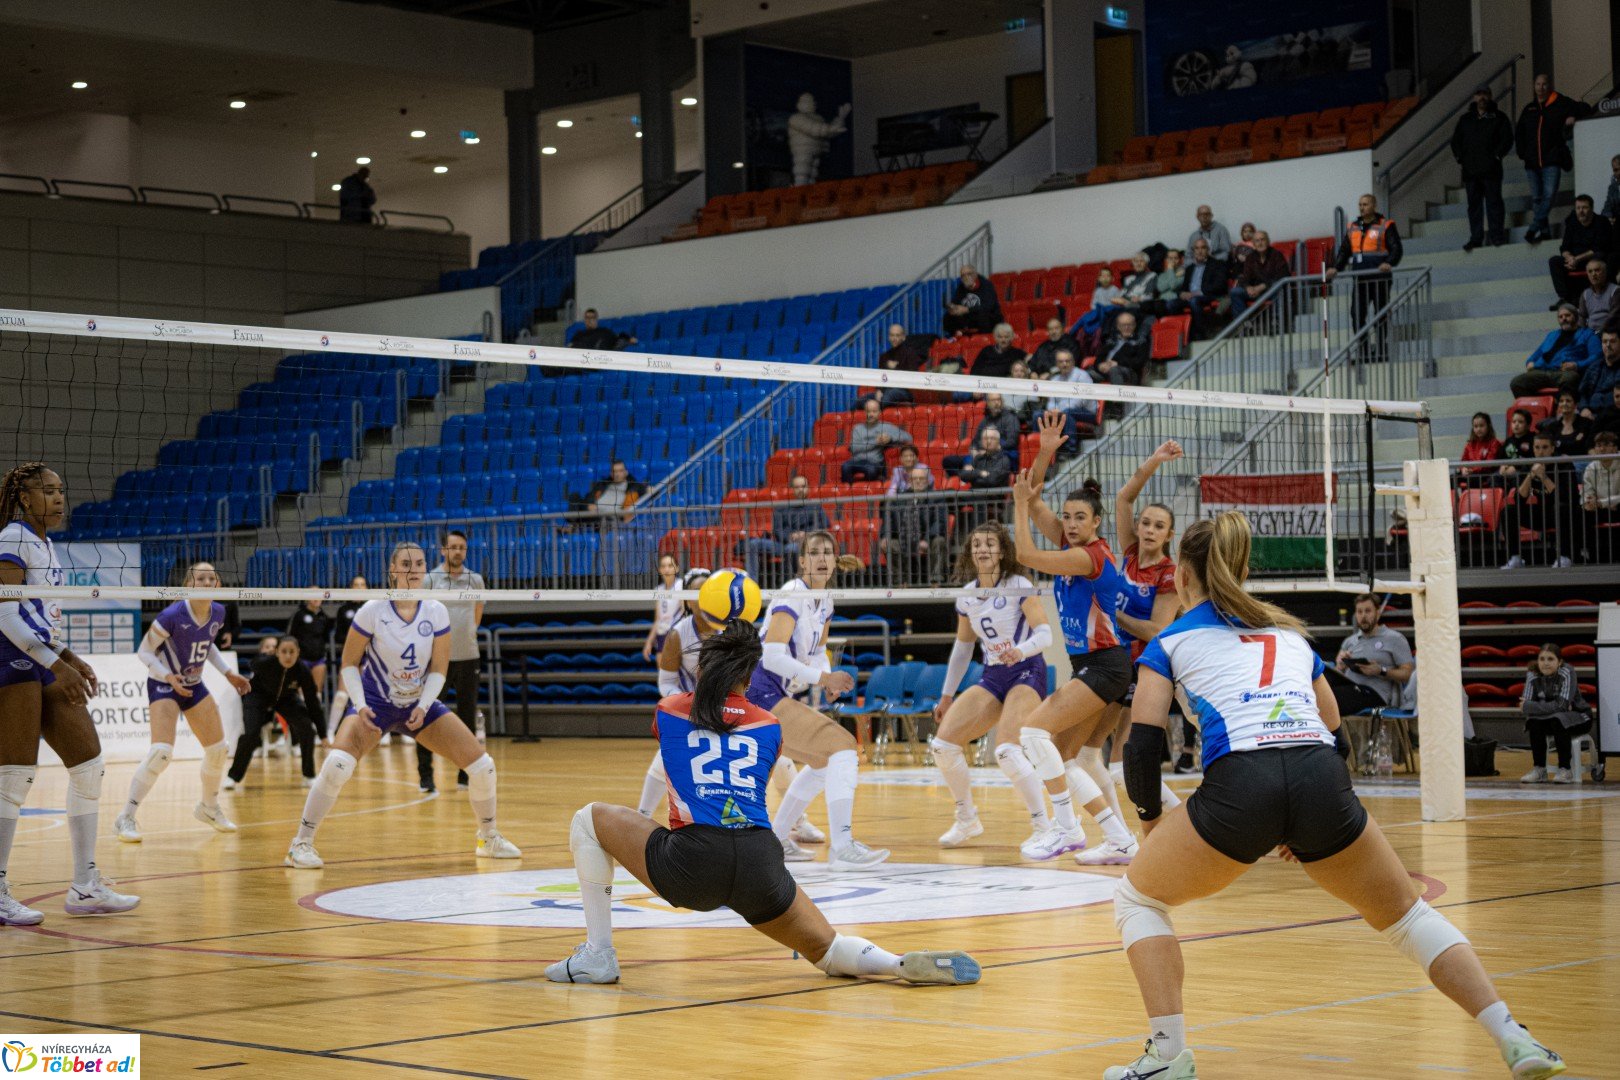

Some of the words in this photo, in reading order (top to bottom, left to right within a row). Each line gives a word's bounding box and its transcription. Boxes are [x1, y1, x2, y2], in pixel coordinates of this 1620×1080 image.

[0, 316, 26, 326] ATUM
[65, 571, 101, 585] IGA
[1, 590, 23, 598] ATUM
[980, 616, 998, 639] 6
[188, 640, 211, 663] 15
[400, 642, 417, 666] 4
[1238, 634, 1276, 688] 7
[98, 681, 145, 698] REGY
[91, 707, 151, 725] ORTCE
[687, 729, 757, 789] 22
